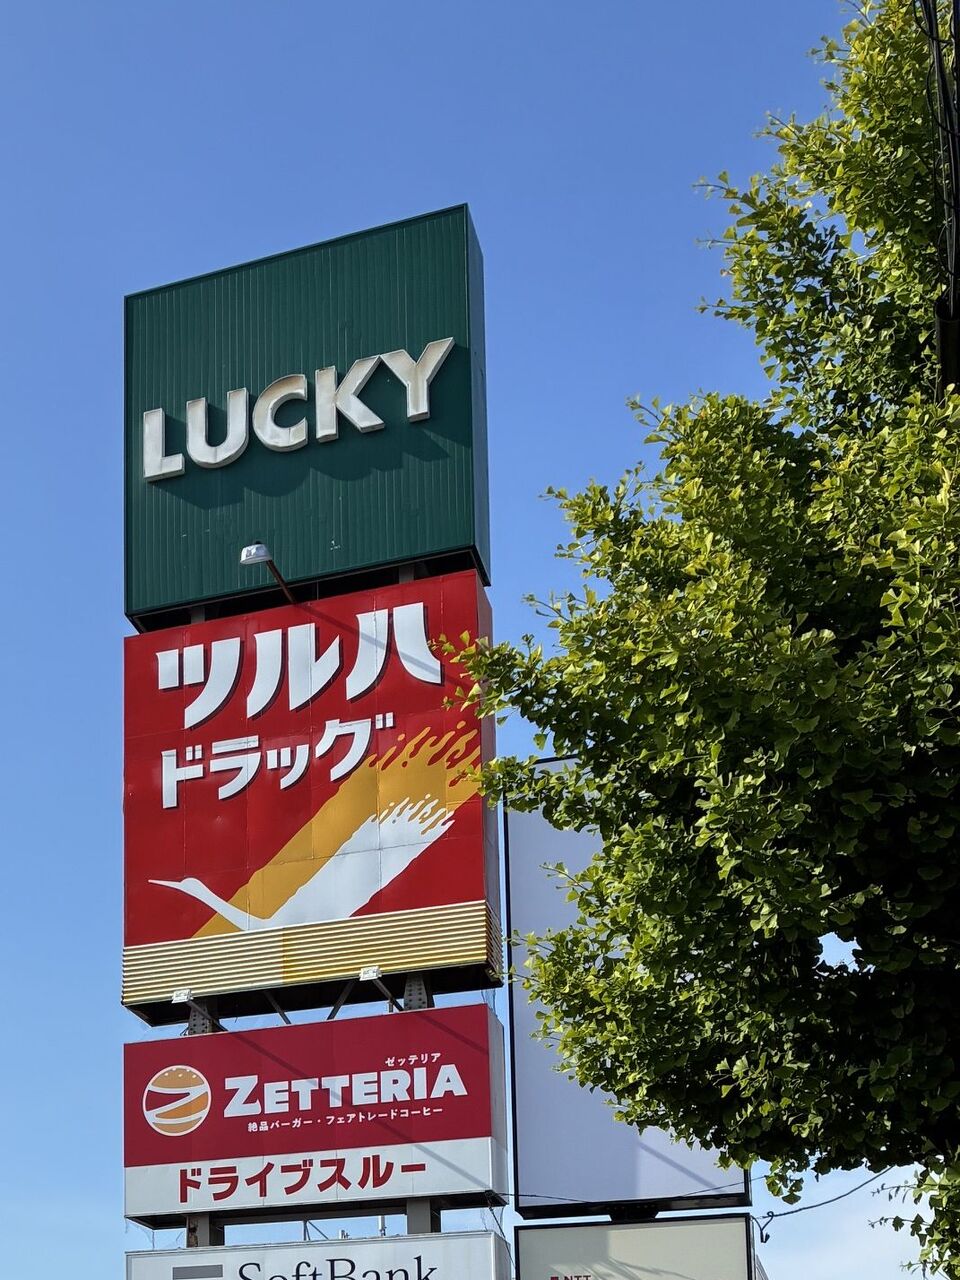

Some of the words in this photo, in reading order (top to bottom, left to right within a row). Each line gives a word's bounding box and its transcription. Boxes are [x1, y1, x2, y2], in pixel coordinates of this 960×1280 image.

[143, 337, 455, 482] LUCKY
[156, 602, 442, 729] ツルハ
[161, 712, 394, 808] ドラッグ
[385, 1053, 441, 1067] ゼッテリア
[223, 1064, 468, 1118] ZETTERIA
[247, 1107, 443, 1132] 絶品バーガー・フェアトレードコーヒー
[179, 1154, 427, 1203] ドライブスルー
